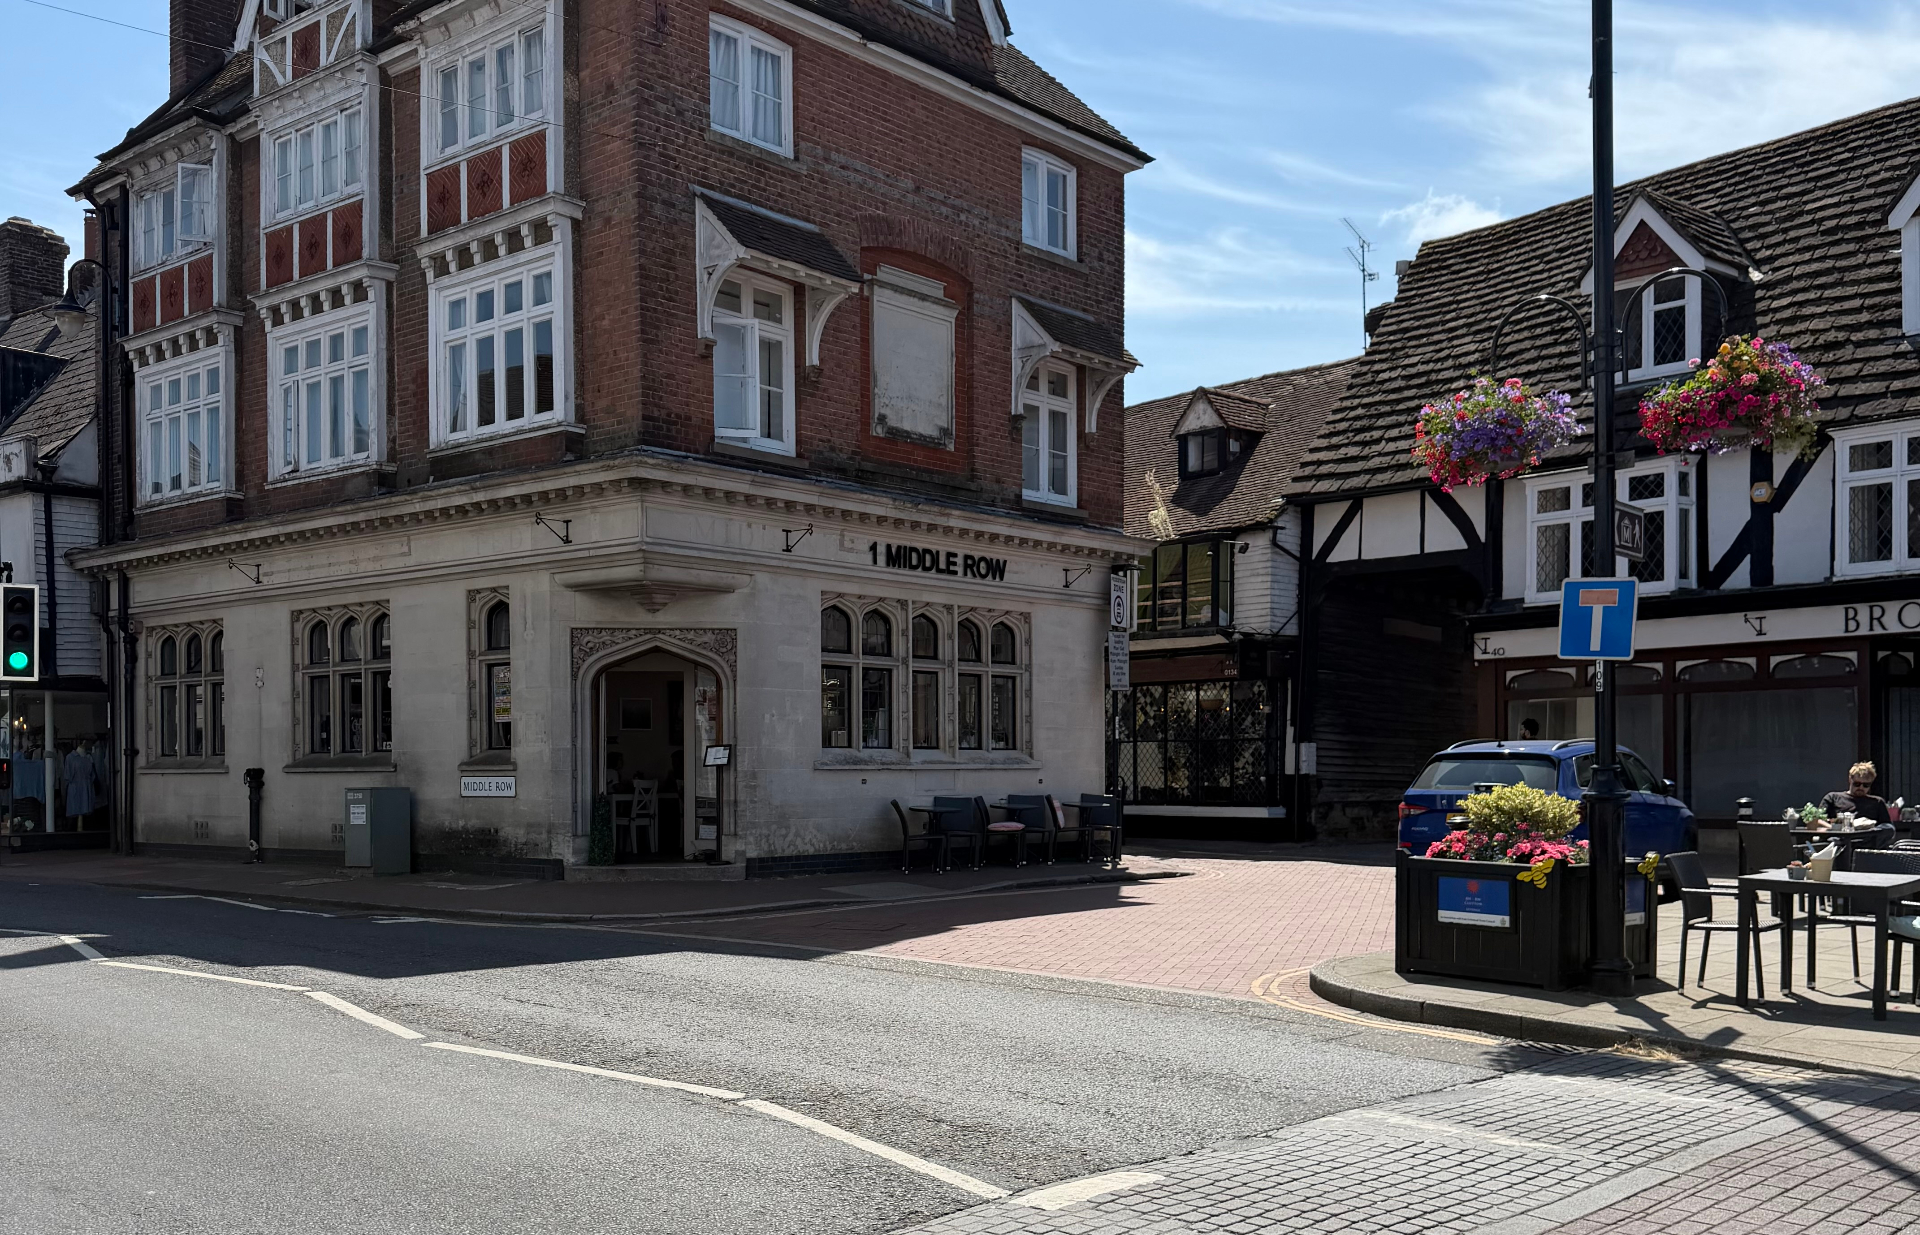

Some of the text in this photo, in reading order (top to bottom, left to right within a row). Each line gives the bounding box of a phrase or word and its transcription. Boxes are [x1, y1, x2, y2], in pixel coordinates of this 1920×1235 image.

[868, 541, 1008, 581] 1 MIDDLE ROW
[1490, 647, 1505, 656] 40
[463, 781, 513, 792] MIDDLE ROW
